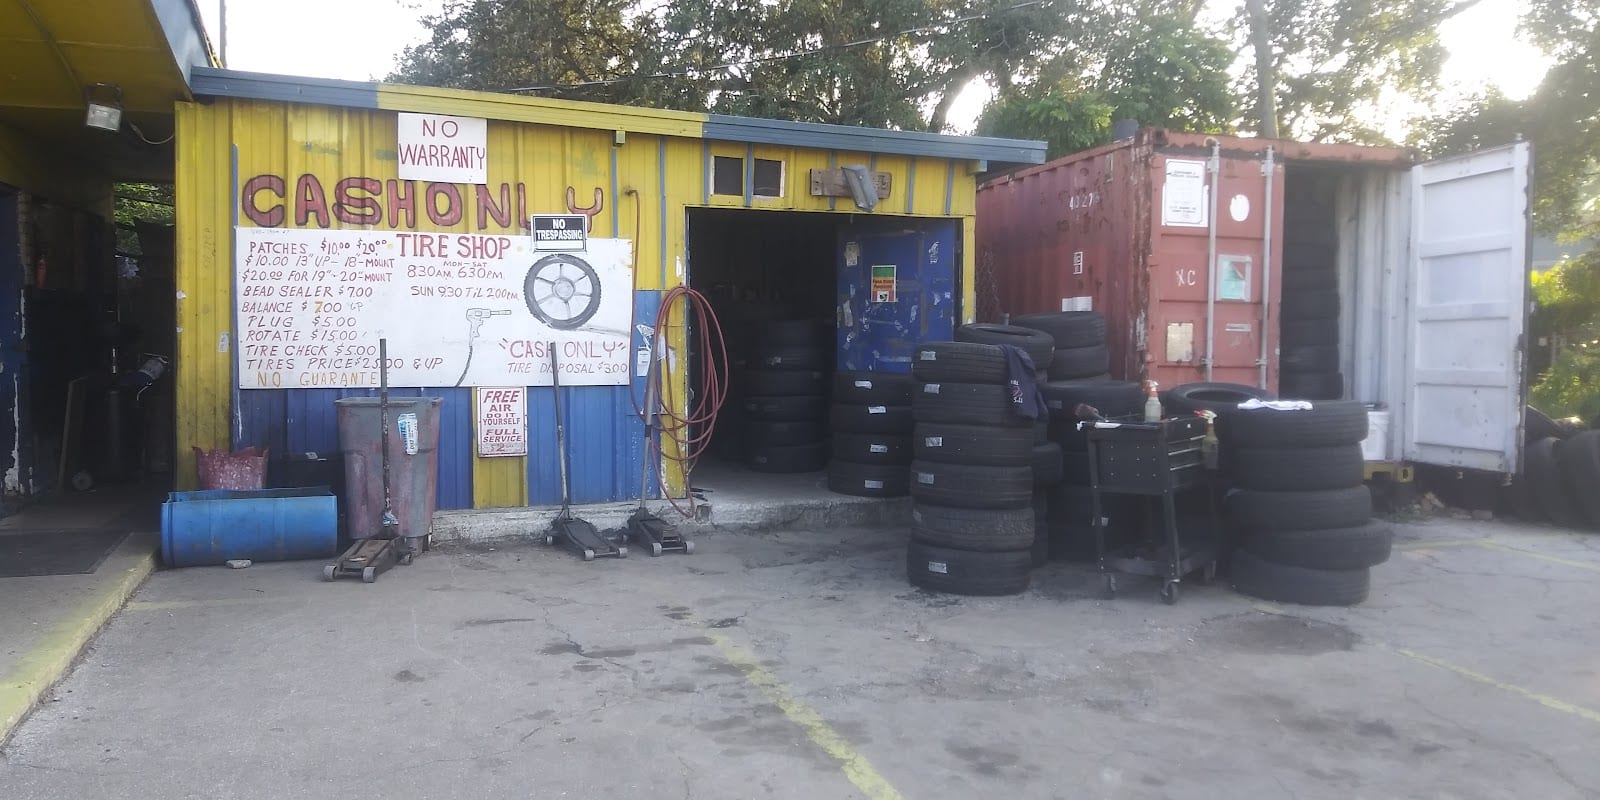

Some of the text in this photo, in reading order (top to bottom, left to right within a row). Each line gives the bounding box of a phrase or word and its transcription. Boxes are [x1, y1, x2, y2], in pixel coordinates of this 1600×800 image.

[423, 119, 459, 138] NO
[399, 143, 485, 170] WARRANTY
[242, 174, 416, 229] CASH
[552, 218, 566, 229] NO
[536, 229, 583, 240] TRESPASSING
[250, 241, 308, 254] PATCHES
[396, 233, 511, 260] TIRE SHOP
[288, 270, 309, 281] FOR
[1176, 270, 1196, 286] XC
[243, 286, 274, 297] BEAD
[279, 286, 333, 297] SEALER
[410, 286, 434, 296] SUN
[242, 302, 293, 313] BALANCE
[248, 316, 294, 327] PLUG
[246, 330, 301, 341] ROTATE
[246, 344, 278, 356] TIRE
[284, 344, 328, 356] CHECK
[246, 359, 295, 369] TIRES
[307, 358, 352, 369] PRICE
[425, 358, 443, 370] UP
[507, 363, 532, 373] TIRE
[540, 363, 595, 373] DIPOSAL
[257, 371, 390, 387] NO GUARANTE
[483, 390, 520, 403] FREE
[490, 404, 512, 412] AIR
[482, 418, 521, 426] YOURSELF
